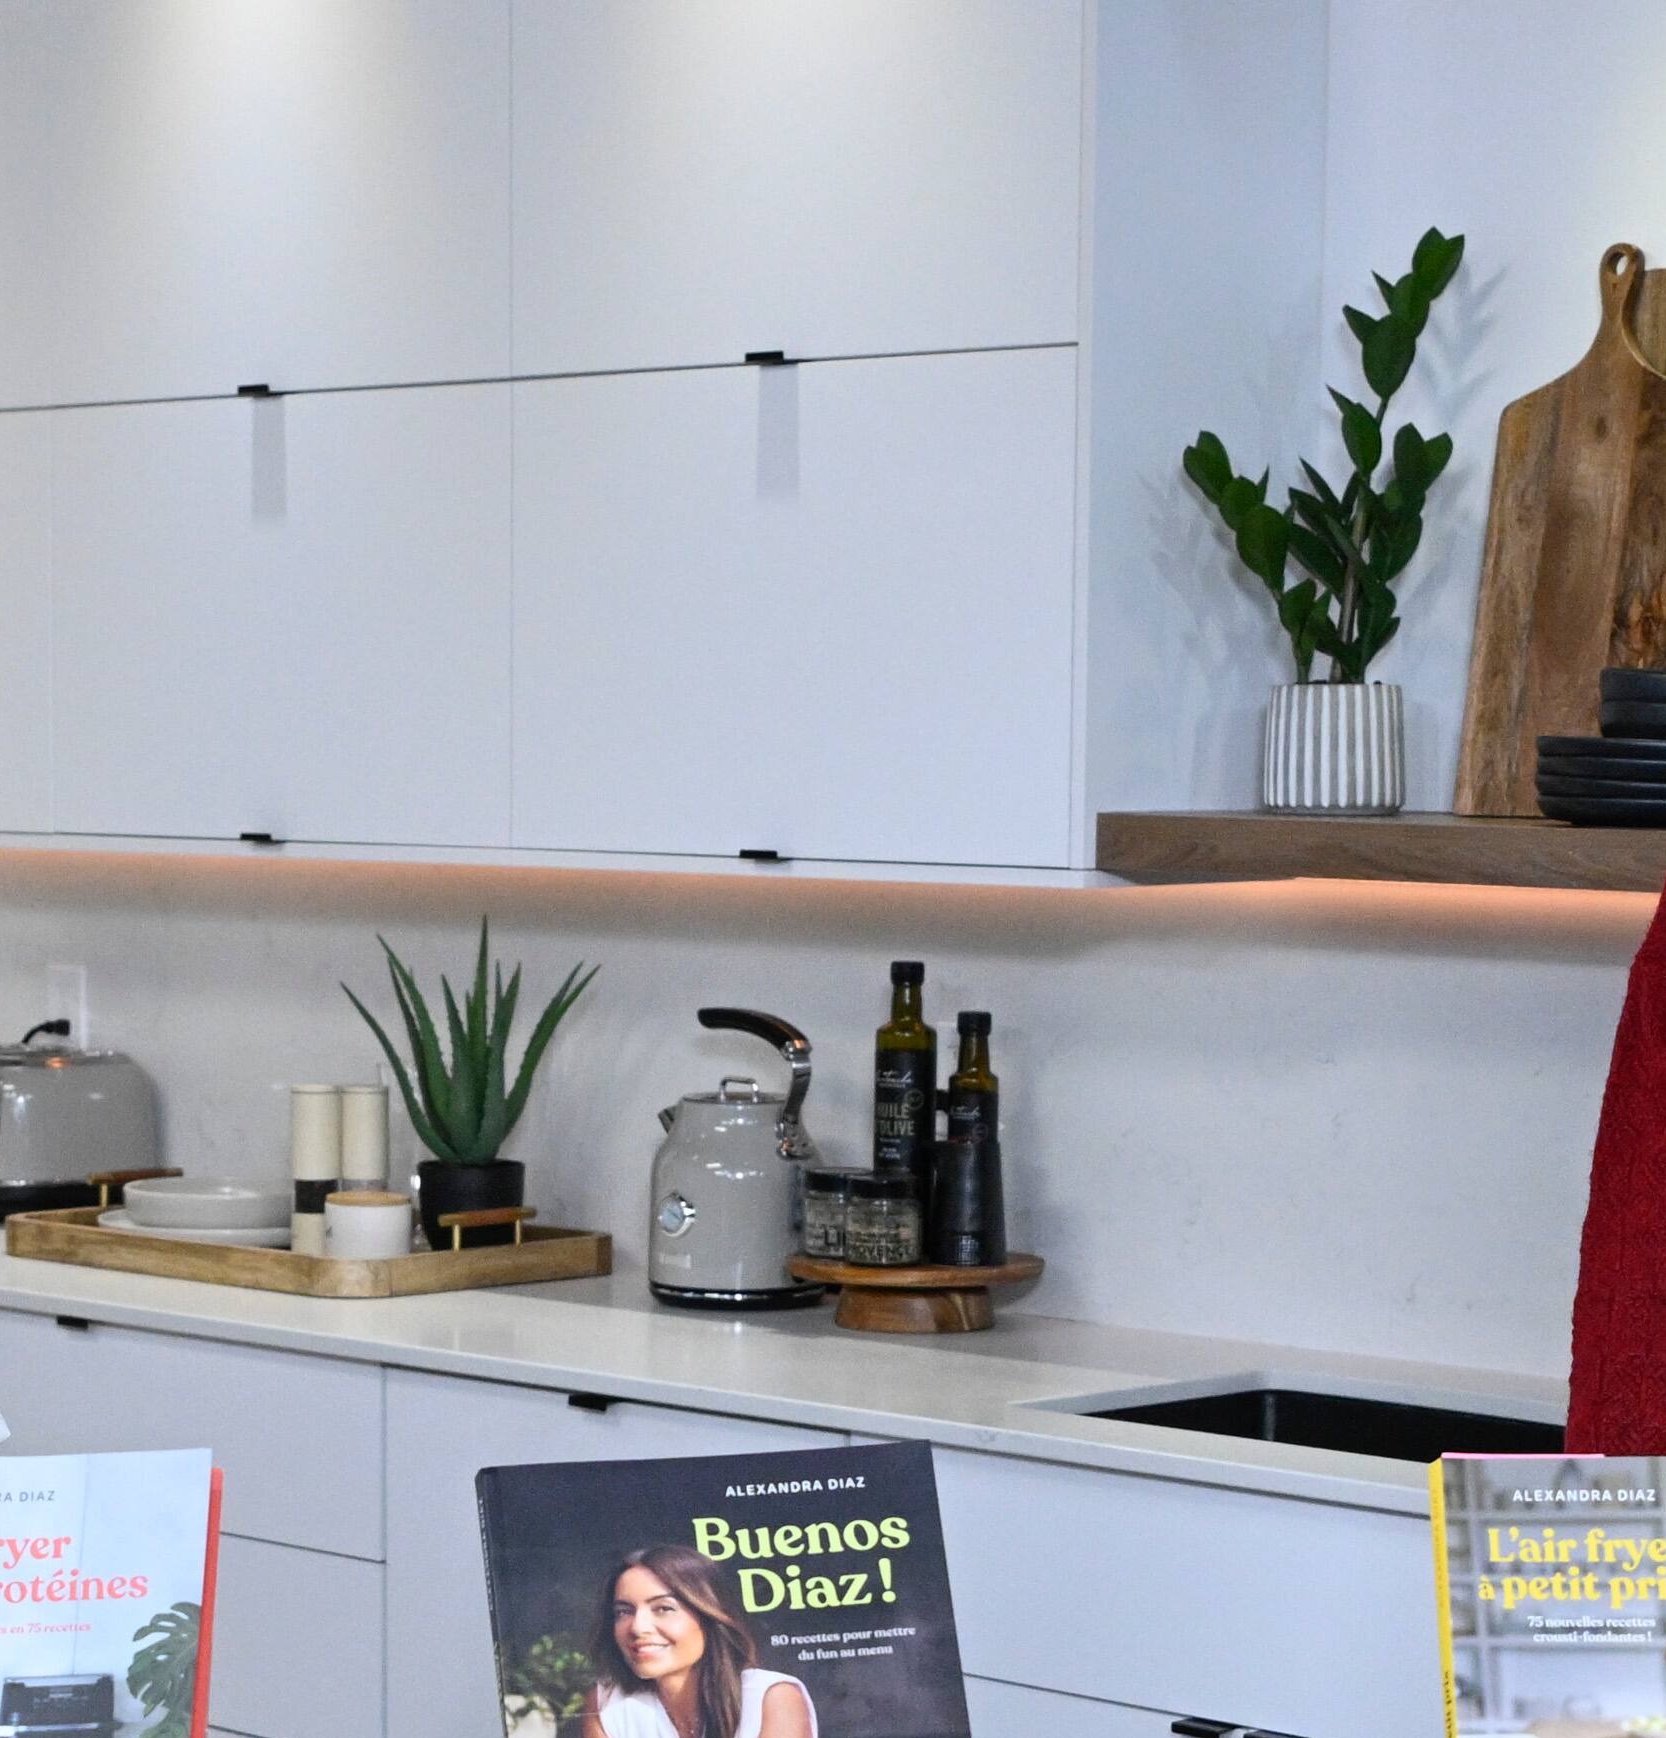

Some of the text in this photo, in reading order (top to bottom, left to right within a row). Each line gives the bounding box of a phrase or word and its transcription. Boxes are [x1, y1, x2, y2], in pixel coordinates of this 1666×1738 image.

[725, 1476, 866, 1497] ALEXANDRA DIAZ
[1512, 1489, 1656, 1501] ALEXANDRA DIAZ
[19, 1490, 56, 1502] DIAZ
[692, 1516, 910, 1561] Buenos
[1488, 1526, 1578, 1563] L'air
[1478, 1575, 1496, 1600] à
[1502, 1566, 1601, 1610] petit
[10, 1625, 25, 1634] en
[27, 1623, 42, 1634] 75
[44, 1622, 92, 1633] recettes
[1527, 1616, 1656, 1628] 75 nouvelles recettes
[771, 1626, 916, 1646] 80 recettes pour mettre
[798, 1645, 893, 1661] du fun au menu
